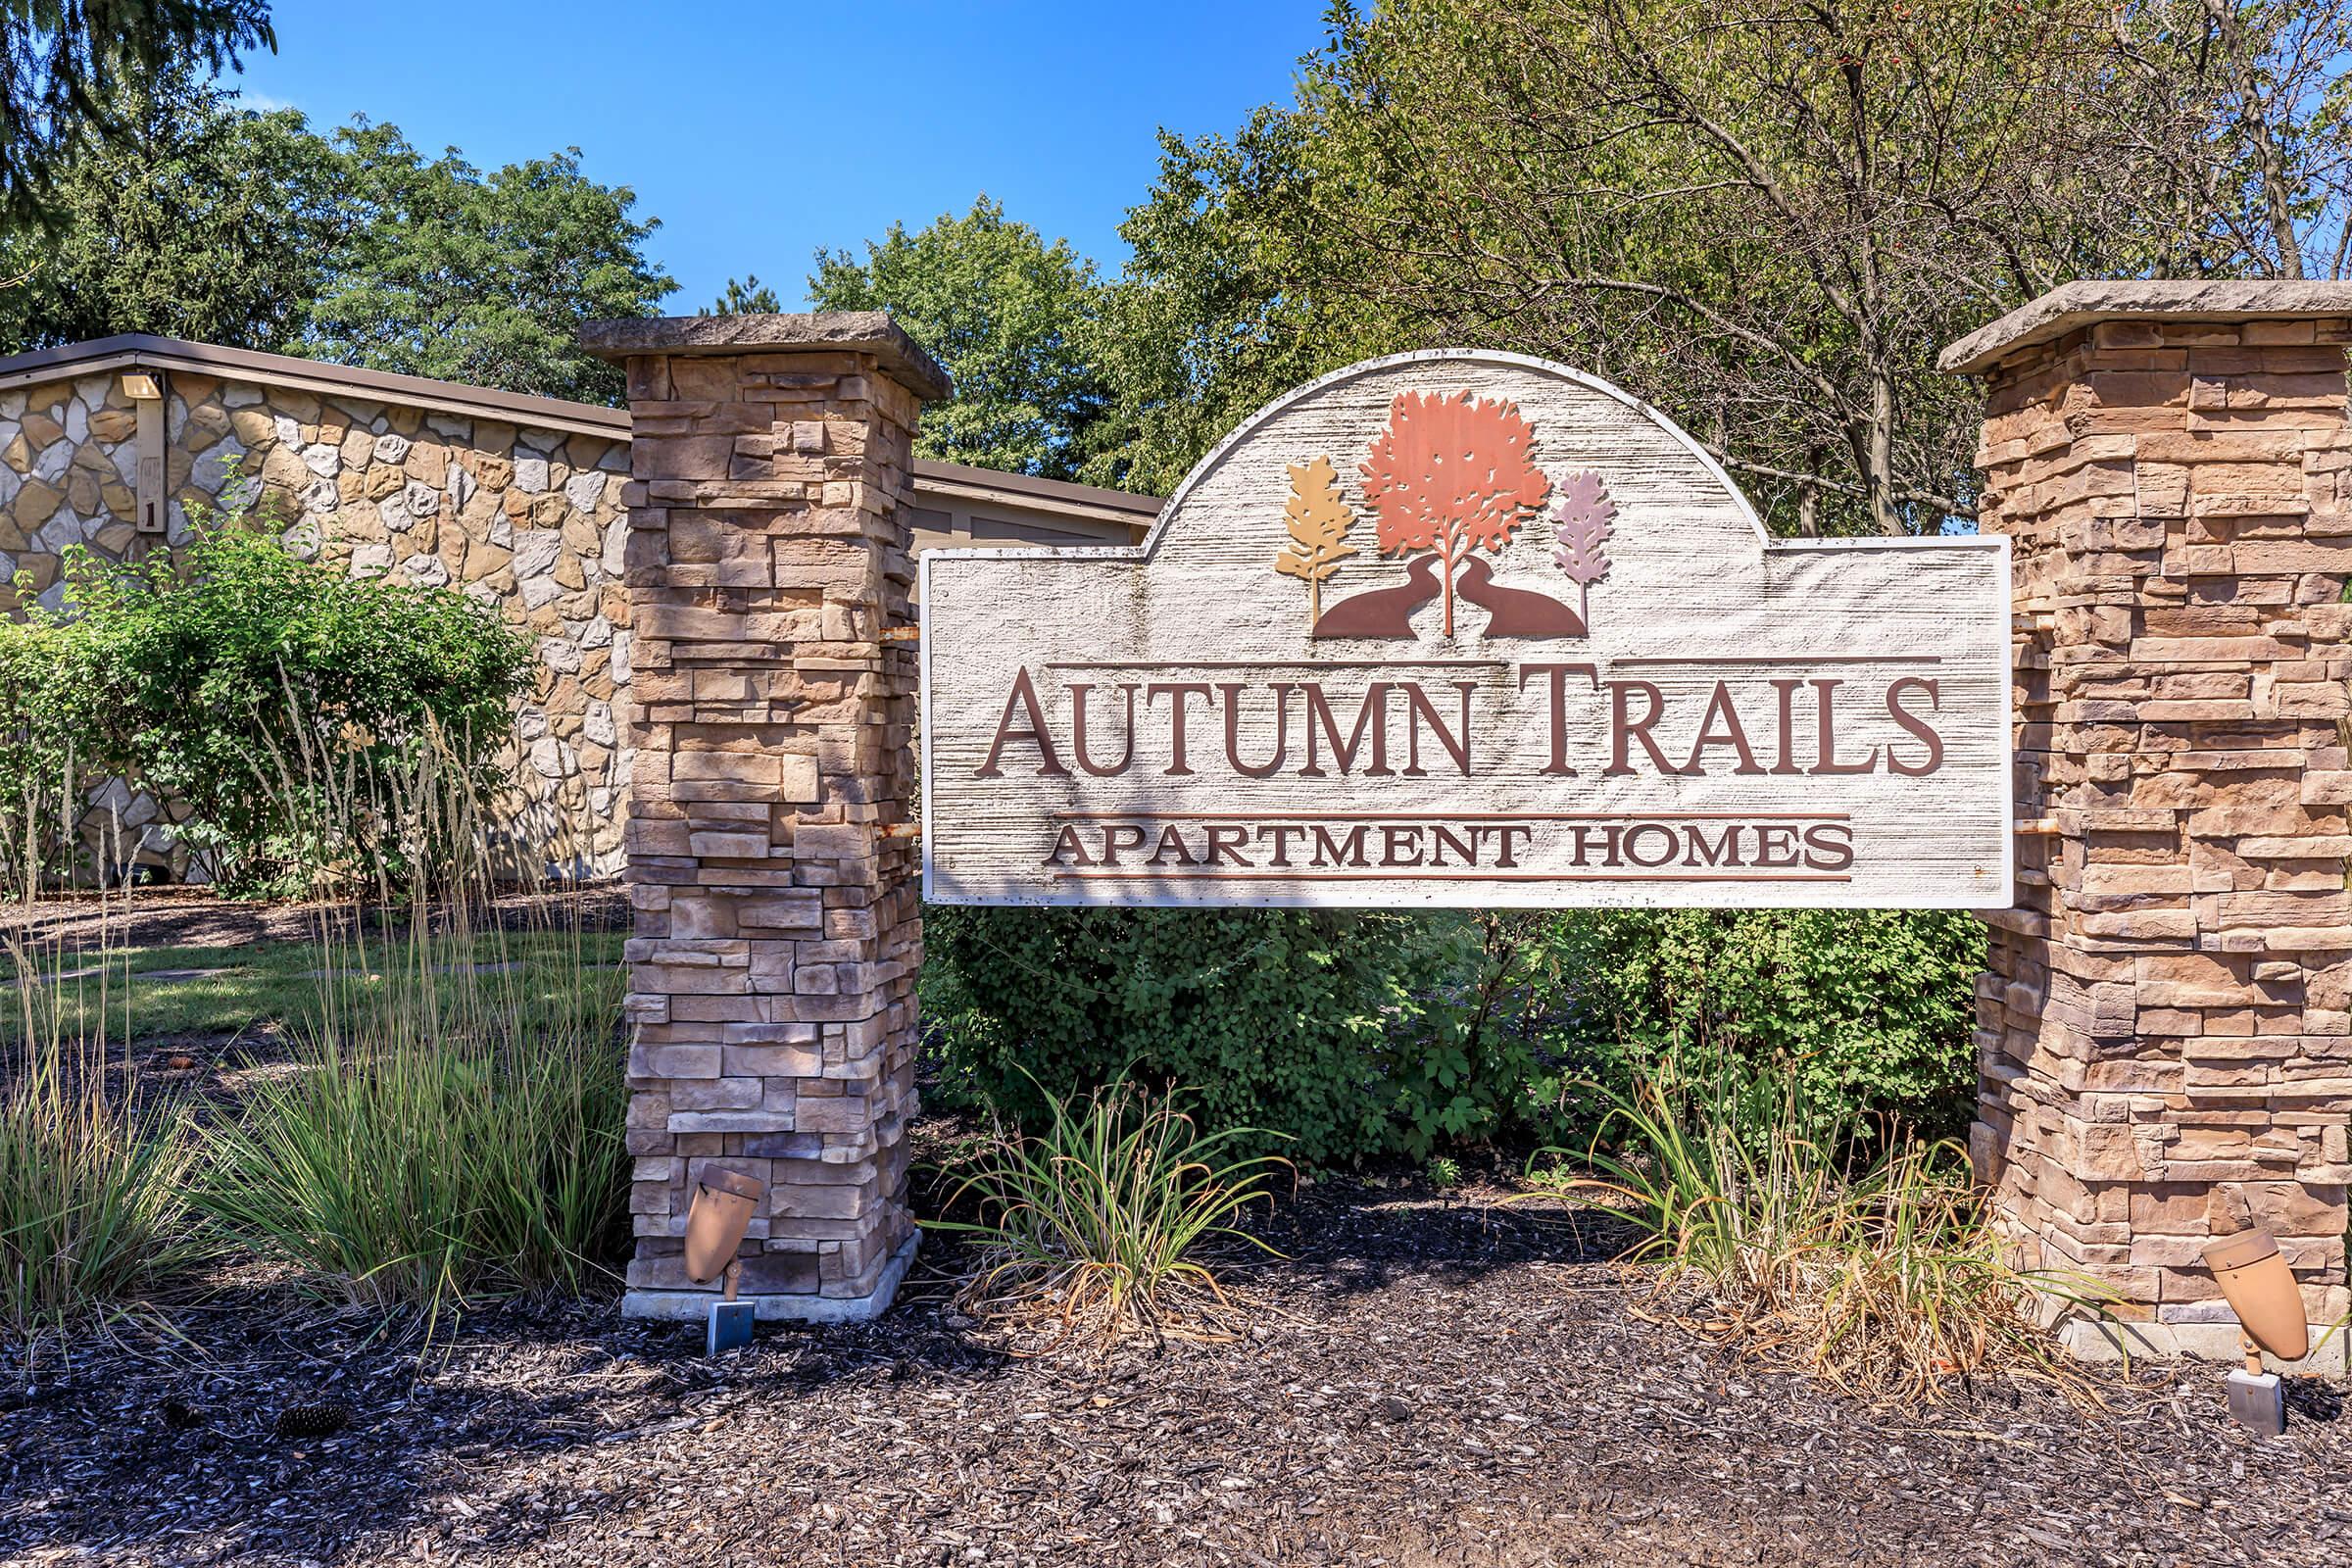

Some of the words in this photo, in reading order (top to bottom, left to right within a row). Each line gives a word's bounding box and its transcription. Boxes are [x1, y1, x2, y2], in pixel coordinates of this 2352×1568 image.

[146, 502, 155, 527] 1
[975, 665, 1478, 777] AUTUMN
[1520, 662, 1941, 777] TRAILS
[1045, 823, 1532, 868] APARTMENT
[1570, 823, 1854, 869] HOMES
